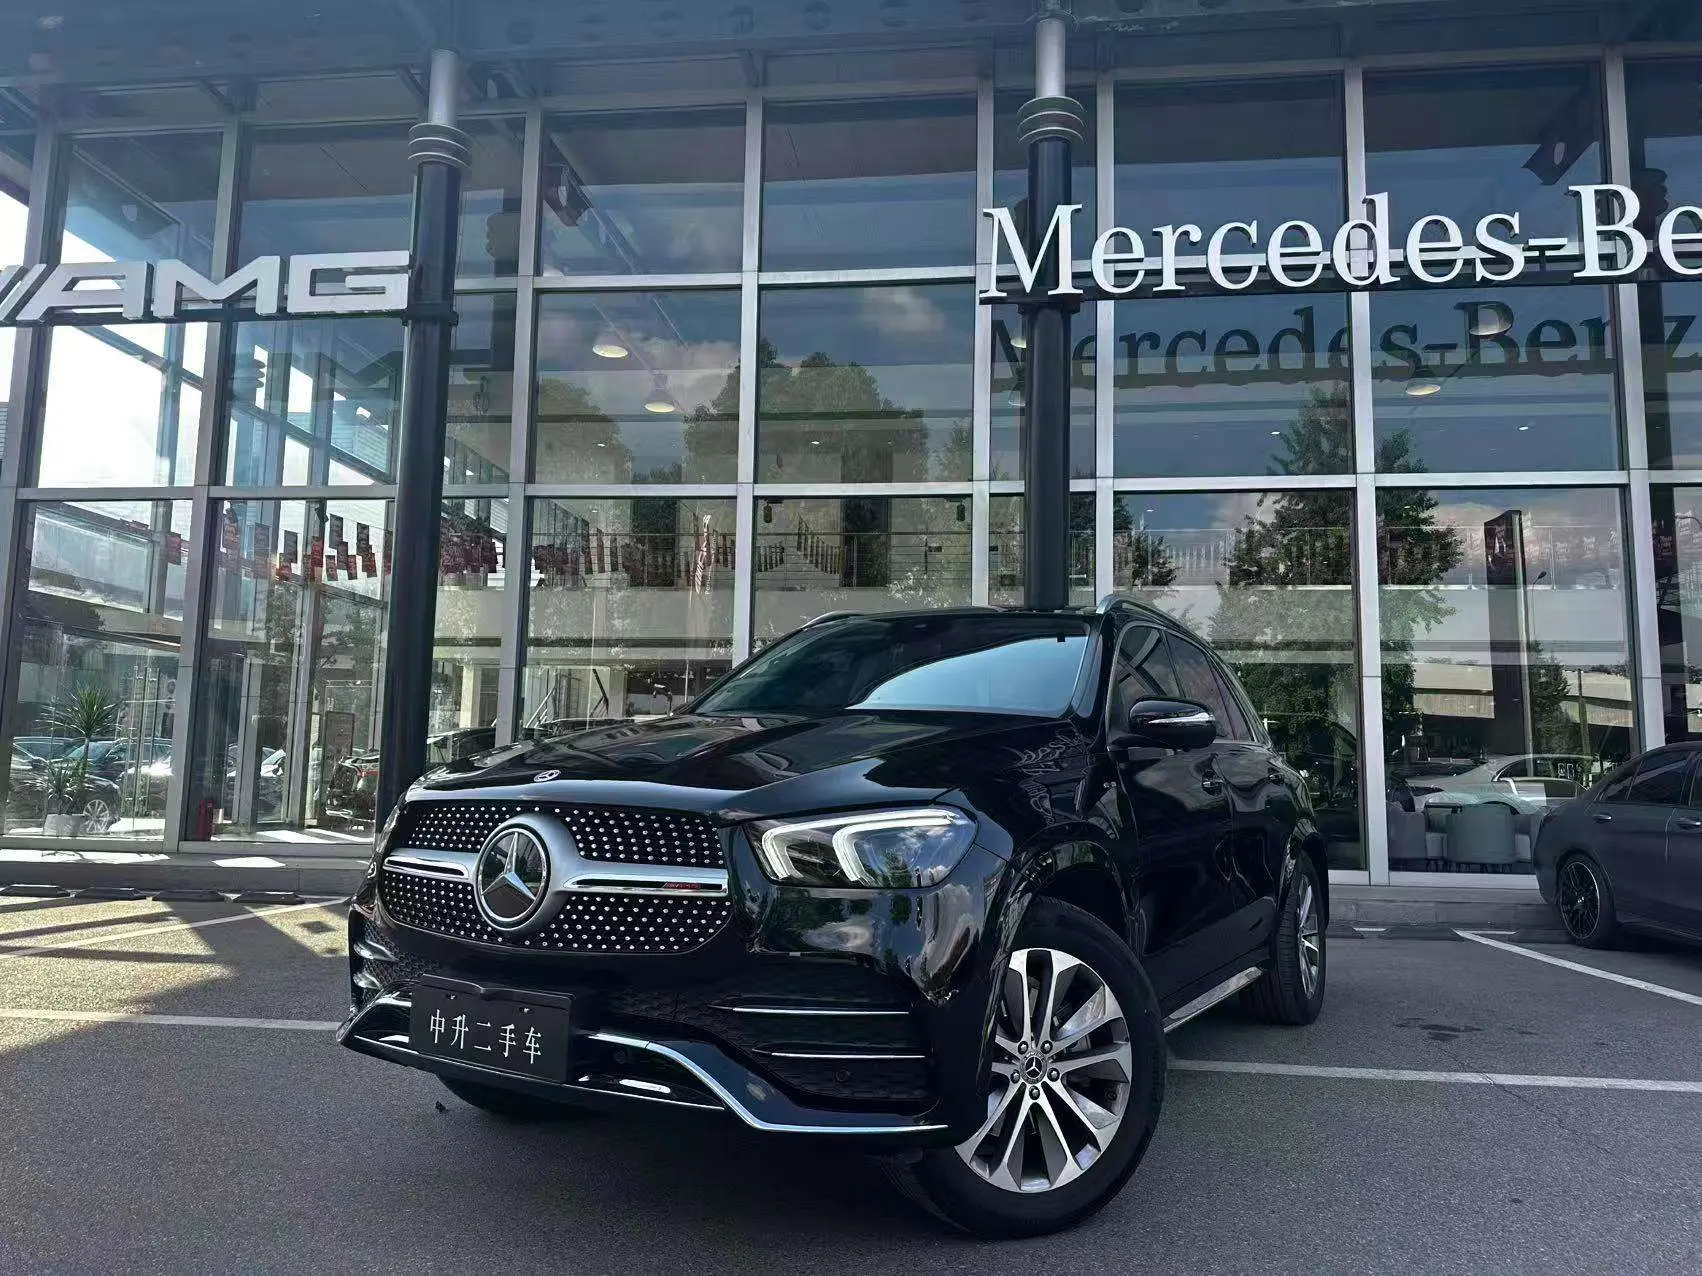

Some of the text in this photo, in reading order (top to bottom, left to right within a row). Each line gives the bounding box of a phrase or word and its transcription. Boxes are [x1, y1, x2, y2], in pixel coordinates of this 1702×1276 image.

[980, 184, 1702, 298] Mercedes-Be
[430, 1009, 542, 1064] 中升二手车
